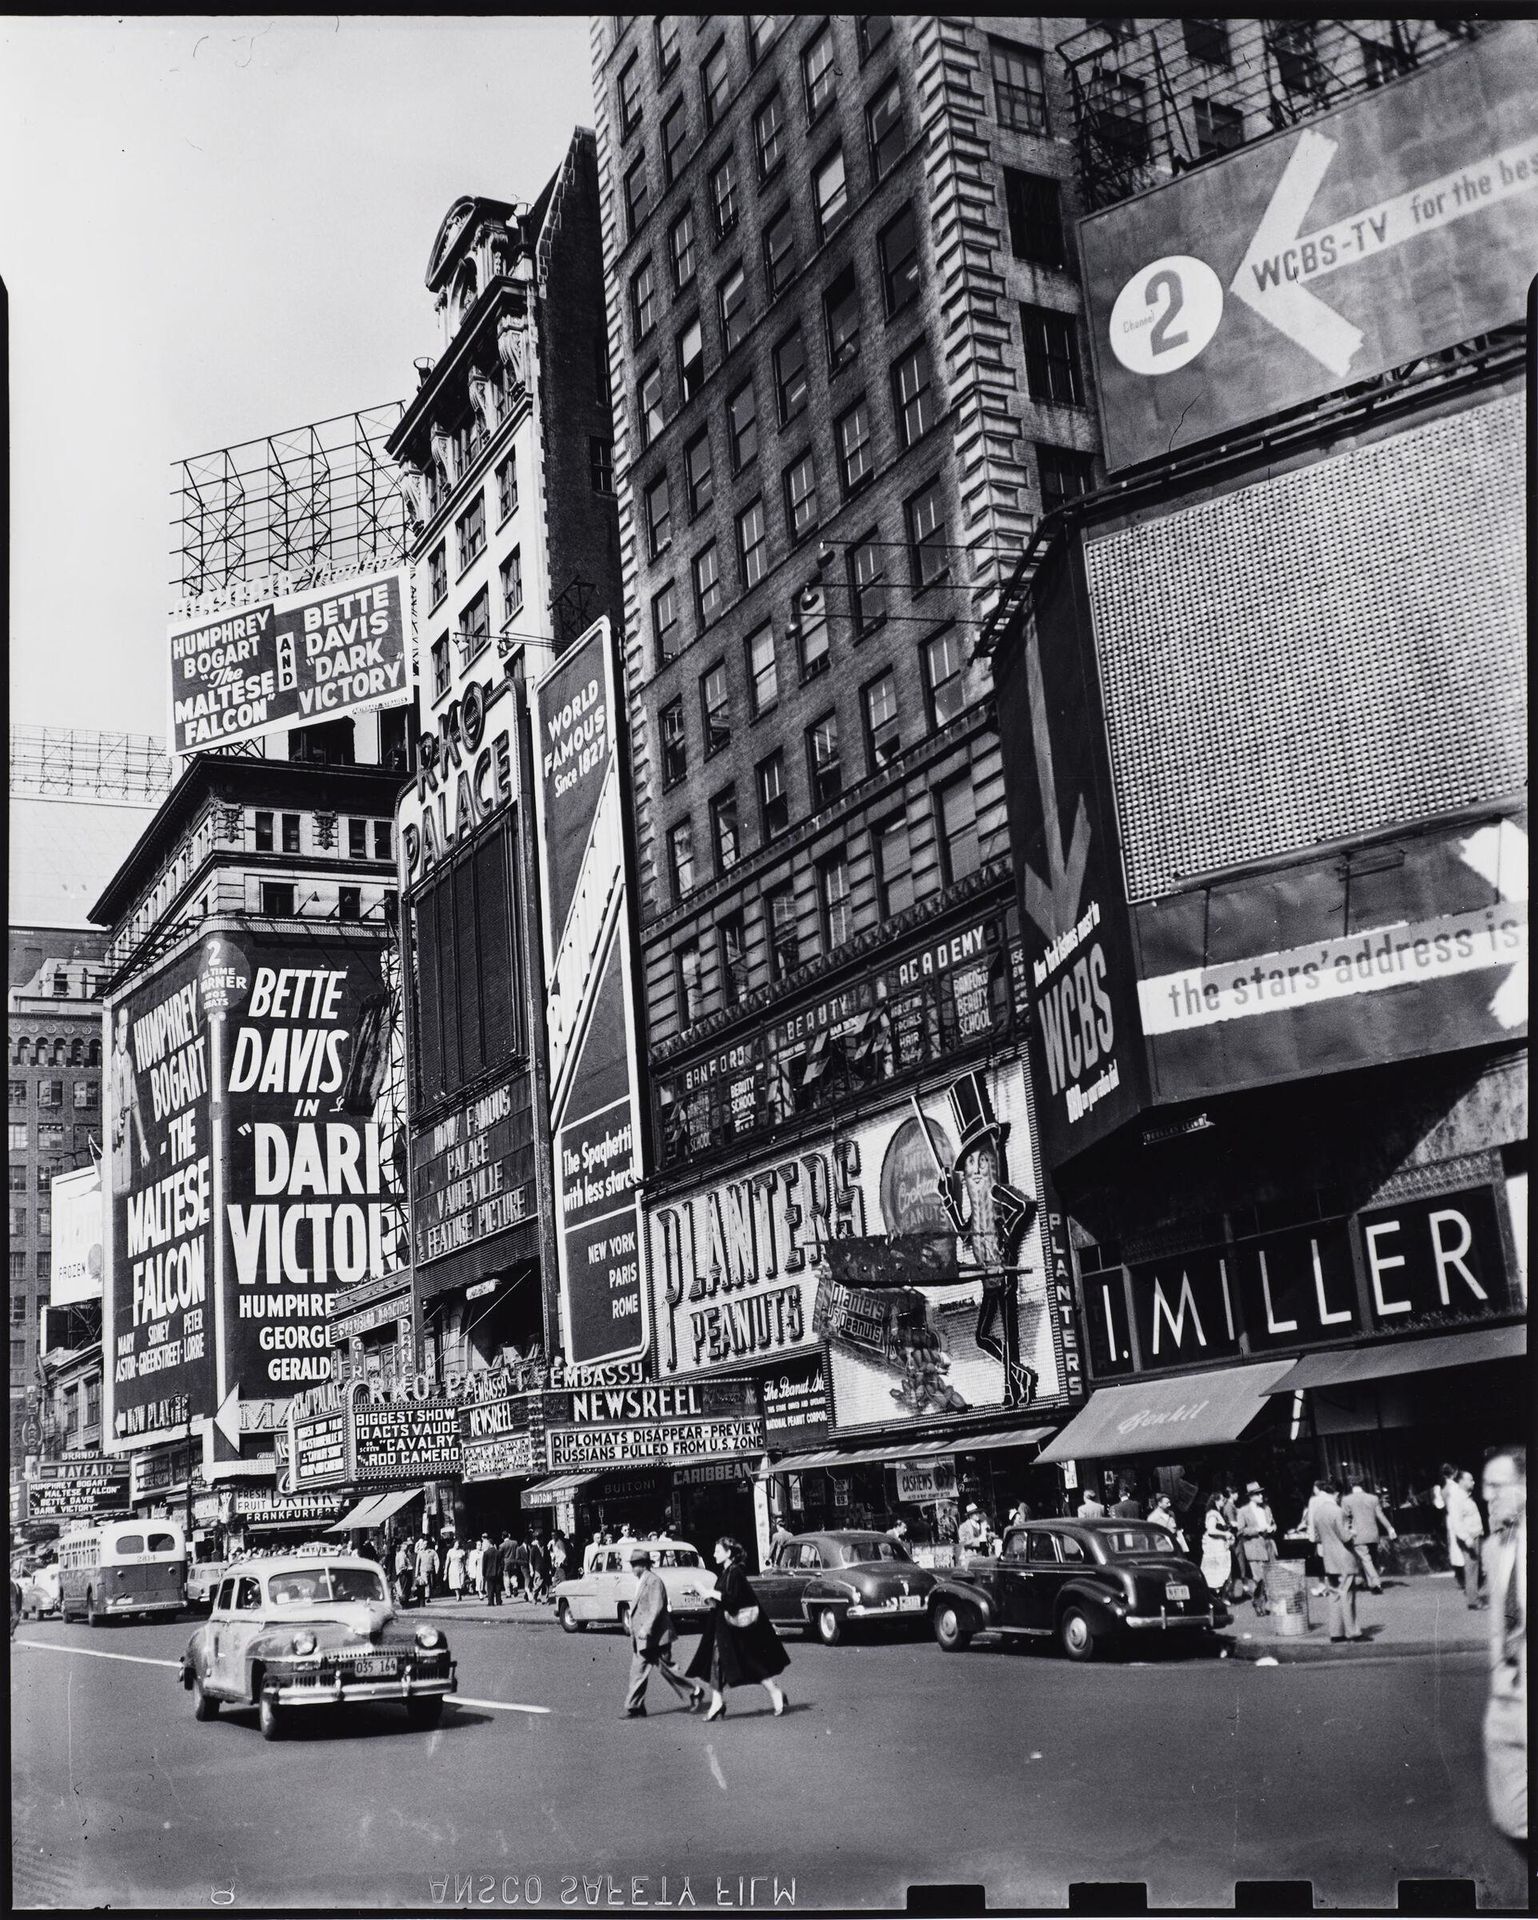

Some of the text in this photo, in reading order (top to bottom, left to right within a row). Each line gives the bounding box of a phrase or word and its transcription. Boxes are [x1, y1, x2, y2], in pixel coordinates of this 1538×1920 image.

[1252, 152, 1538, 292] WCBS-TV for the bes
[1123, 309, 1156, 334] Channel
[1144, 268, 1189, 357] 2
[304, 583, 390, 633] BETTE
[172, 609, 272, 660] HUMPHREY
[305, 610, 390, 658] DAVIS
[183, 635, 260, 679] BOGART
[279, 637, 294, 687] AND
[174, 669, 275, 725] MALTESE
[547, 679, 599, 742] WORLD
[416, 680, 485, 805] RKO
[543, 704, 606, 778] FAMOUS
[554, 734, 606, 798] Since 1827
[402, 729, 512, 893] PALACE
[207, 940, 221, 967] 2
[210, 967, 236, 976] TIME
[900, 925, 983, 987] ACADEMY
[1169, 980, 1221, 1018] the
[1335, 922, 1474, 985] address
[1486, 911, 1521, 951] is
[248, 967, 348, 1020] BETTE
[957, 987, 988, 1017] BEAUTY
[133, 978, 199, 1074] HUMPHREY
[787, 994, 847, 1040] BEAUTY
[959, 1008, 992, 1038] SCHOOL
[1038, 943, 1113, 1097] WCBS
[150, 1036, 208, 1122] BOGART
[228, 1027, 350, 1093] DAVIS
[686, 1046, 745, 1090] BANFORD
[294, 1099, 320, 1116] IN
[730, 1075, 755, 1099] BEAUTY
[731, 1092, 756, 1114] SCHOOL
[466, 1085, 511, 1137] FAMOUS
[447, 1132, 489, 1181] PALACE
[563, 1124, 632, 1177] The Spaghetti
[436, 1160, 503, 1220] VAUDEVILLE
[563, 1156, 643, 1212] with less starch
[127, 1157, 210, 1259] MALTESE
[427, 1187, 526, 1259] FEATURE PICTURE
[227, 1203, 410, 1285] VICTOR
[588, 1231, 636, 1265] NEW YORK
[656, 1139, 869, 1370] PLANTERS
[133, 1234, 205, 1326] FALCON
[608, 1262, 638, 1289] PARIS
[1152, 1208, 1488, 1356] MILLER
[239, 1292, 336, 1319] HUMPHRE
[611, 1293, 639, 1319] ROME
[692, 1285, 804, 1362] PEANUTS
[1048, 1213, 1081, 1396] PLANTERS
[147, 1320, 170, 1347] SIDNEY
[183, 1308, 203, 1335] PETER
[367, 1373, 430, 1404] RKO
[474, 1378, 508, 1403] EMBASSY
[573, 1386, 702, 1423] NEWSREEL
[763, 1380, 779, 1402] The
[779, 1376, 809, 1399] Peanut
[126, 1404, 146, 1434] NOW
[356, 1408, 456, 1426] BIGGEST SHOW
[356, 1421, 460, 1440] 10 ACTS VAUDE
[470, 1401, 514, 1437] NEWSREEL
[766, 1417, 788, 1431] NATIONAL
[787, 1413, 806, 1427] PEANUT
[368, 1451, 397, 1466] ROD
[401, 1448, 459, 1463] CAMERO
[553, 1431, 628, 1449] DIPLOMATS
[553, 1448, 616, 1464] RUSSIANS
[621, 1443, 669, 1459] PULLED
[673, 1440, 707, 1455] FROM
[732, 1435, 764, 1449] ZONE
[30, 1479, 108, 1491] HUMPHREY BOGART
[57, 1463, 114, 1478] MAYFAIR
[604, 1478, 657, 1495] BUITONI
[673, 1461, 752, 1487] CARIBBEAN
[902, 1473, 933, 1493] CASHEWS
[40, 1497, 66, 1507] BETTE
[70, 1495, 95, 1504] DAVIS
[44, 1488, 82, 1498] MALTESE
[237, 1489, 267, 1499] FRESH
[237, 1500, 267, 1511] FRUIT
[379, 1656, 398, 1673] 164
